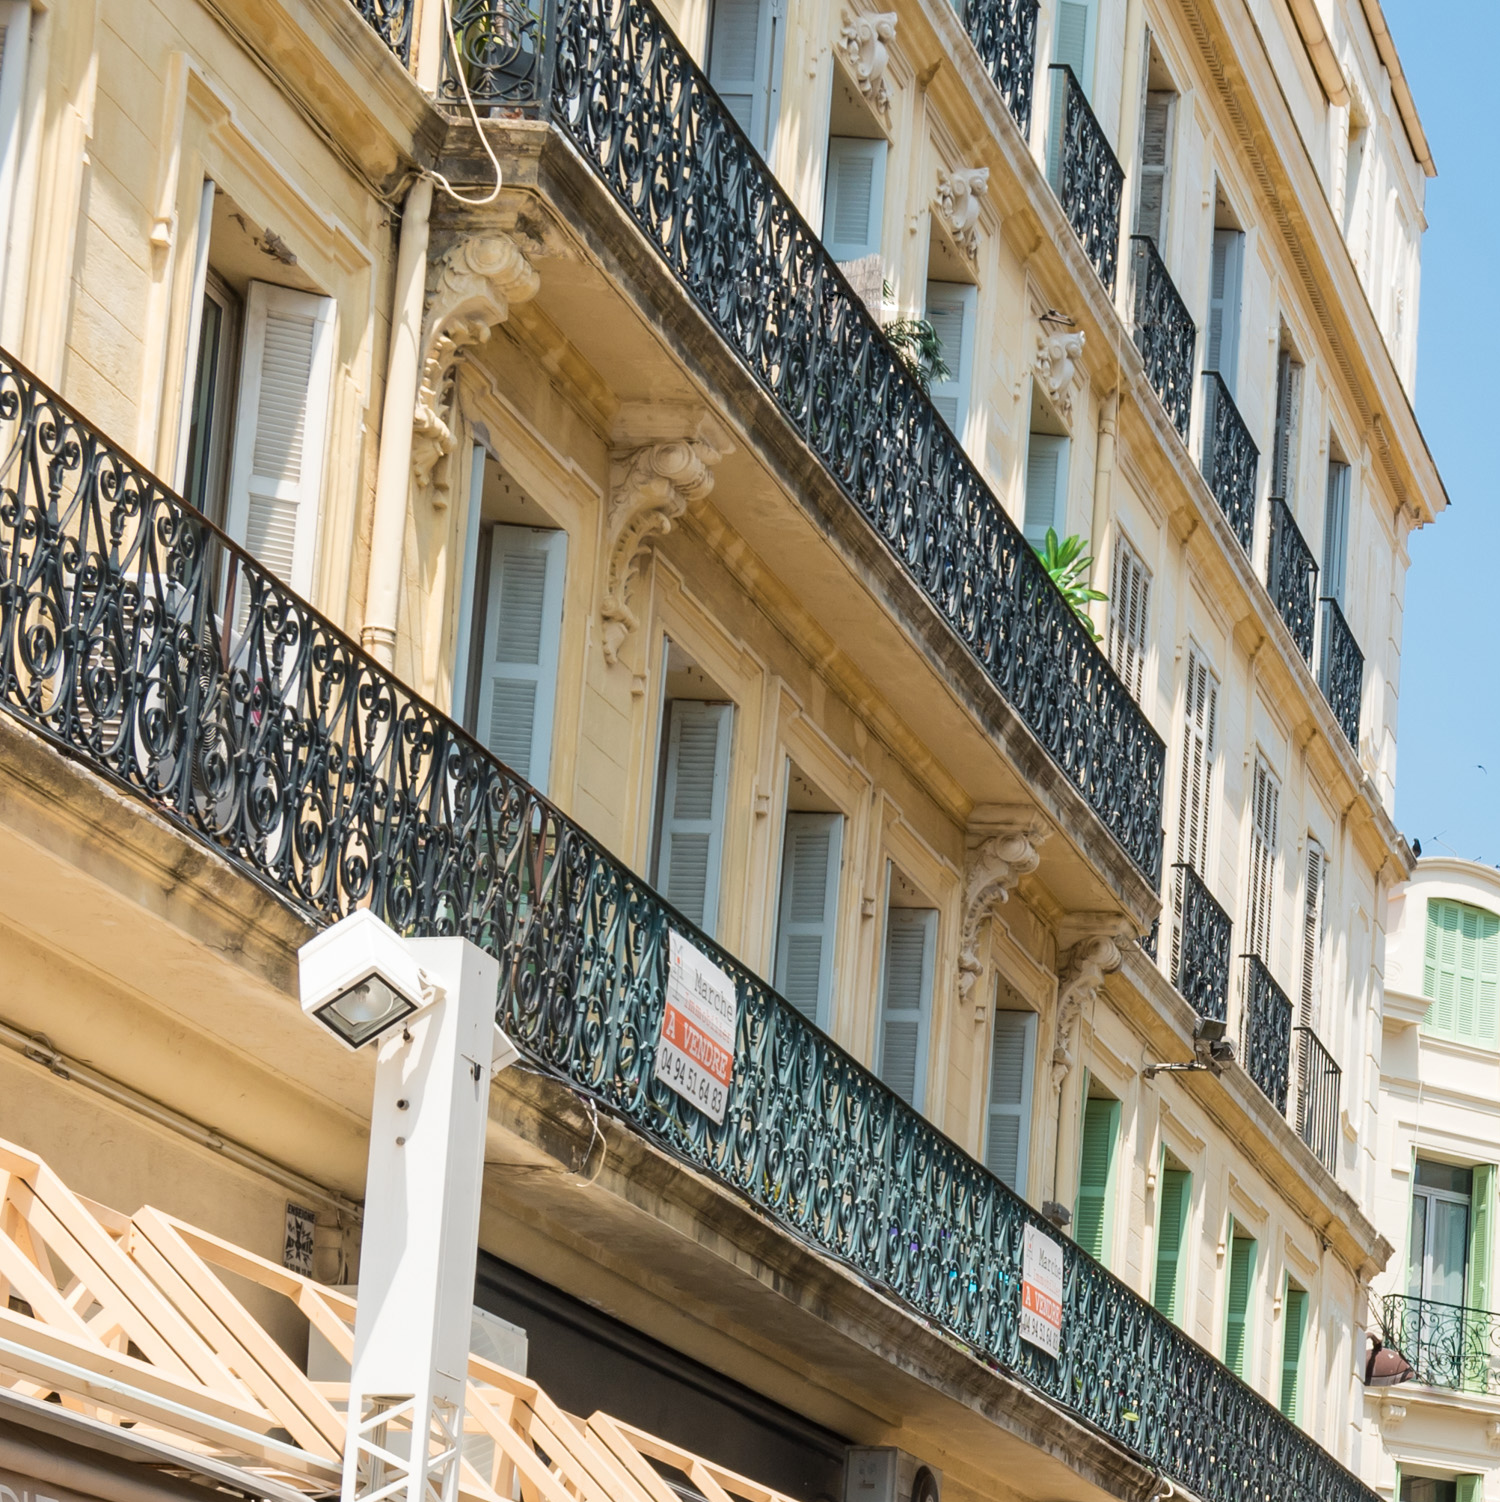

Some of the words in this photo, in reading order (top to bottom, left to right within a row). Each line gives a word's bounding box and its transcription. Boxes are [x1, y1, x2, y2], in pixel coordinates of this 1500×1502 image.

[694, 968, 733, 1022] Marche
[666, 1010, 676, 1040] A
[684, 1021, 728, 1081] VENDRE
[661, 1047, 672, 1075] 04
[673, 1057, 685, 1085] 94
[686, 1067, 697, 1095] 51
[699, 1078, 709, 1105] 64
[711, 1088, 723, 1114] 83
[1025, 1285, 1031, 1307] A
